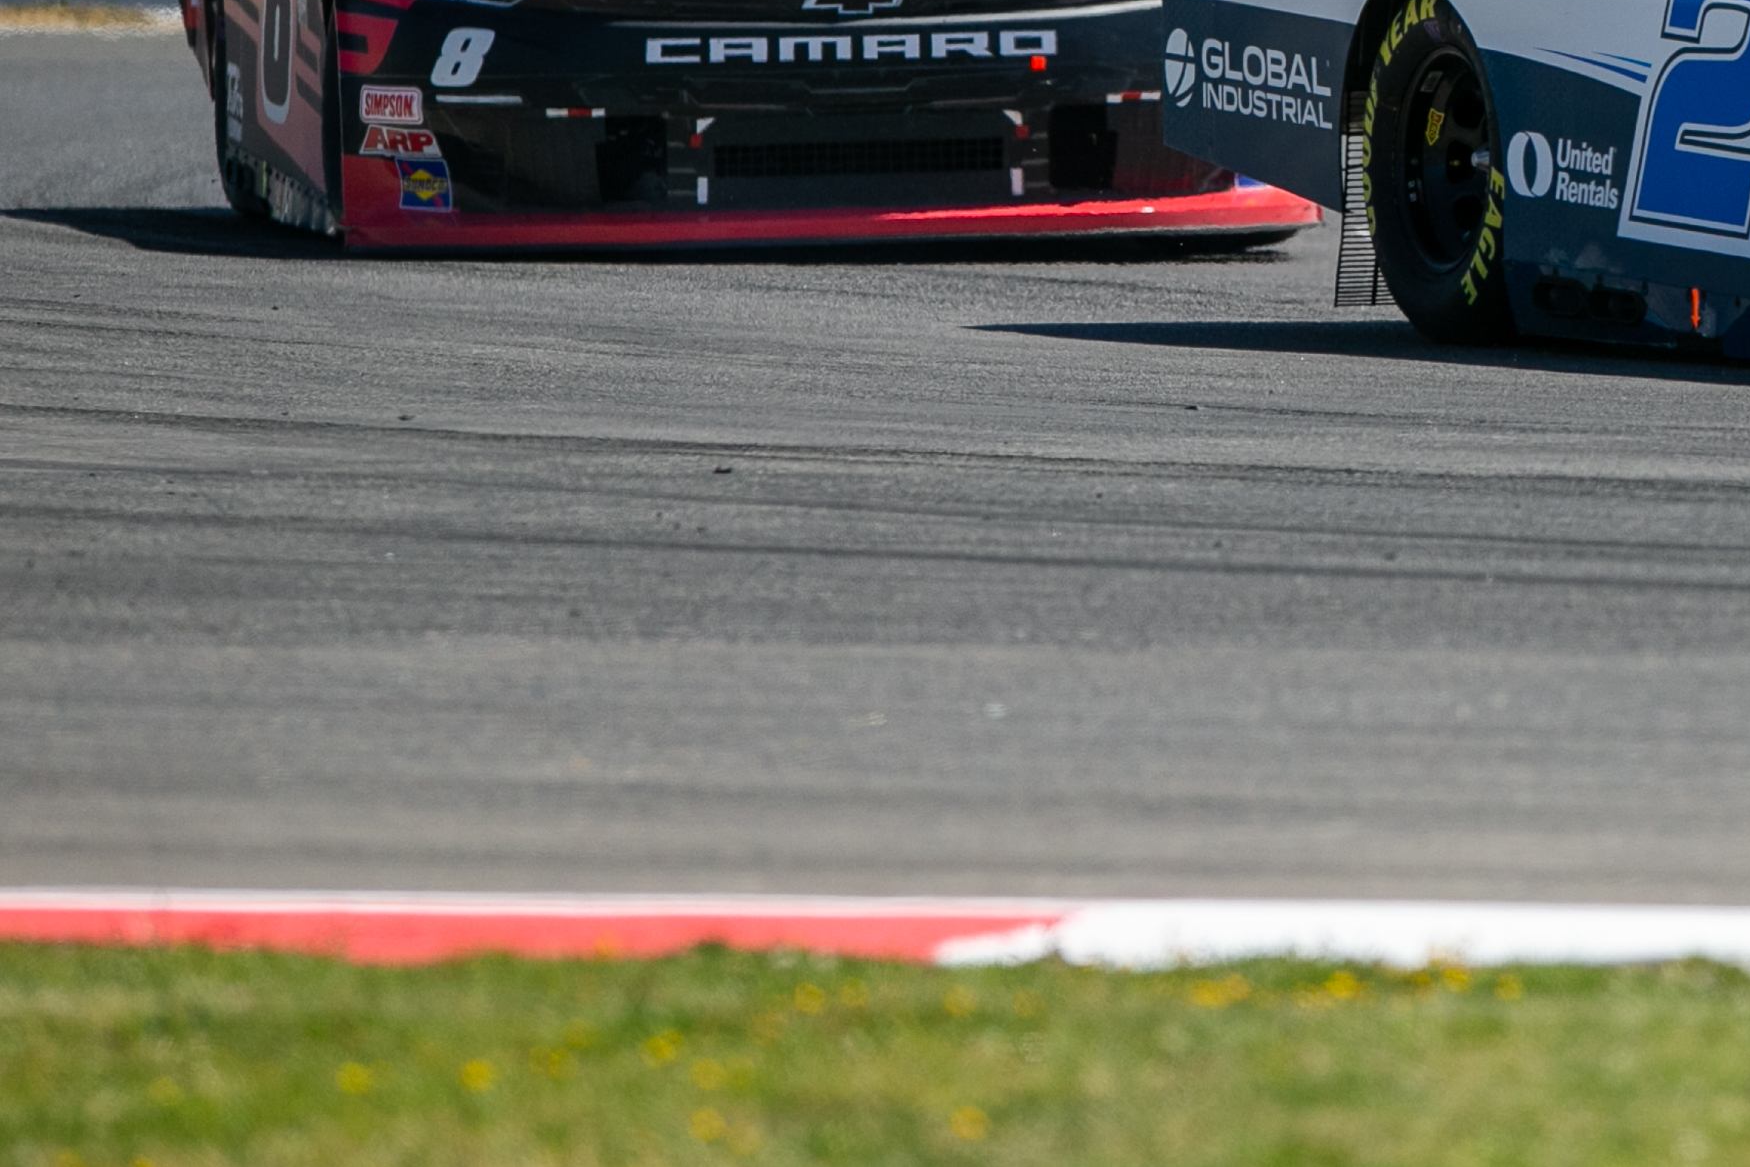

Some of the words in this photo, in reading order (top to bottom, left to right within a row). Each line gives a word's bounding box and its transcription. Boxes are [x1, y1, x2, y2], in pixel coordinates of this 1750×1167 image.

[430, 27, 496, 87] 8
[646, 30, 1058, 65] CAMARO
[1202, 38, 1332, 97] GLOBAL
[364, 92, 415, 119] SIMPSON
[1202, 82, 1333, 130] INDUSTRIAL
[363, 126, 434, 154] ARP
[1556, 137, 1615, 176] United
[402, 177, 448, 195] SUNOCO
[1555, 170, 1619, 210] Rentals
[1461, 166, 1506, 306] EAGLE
